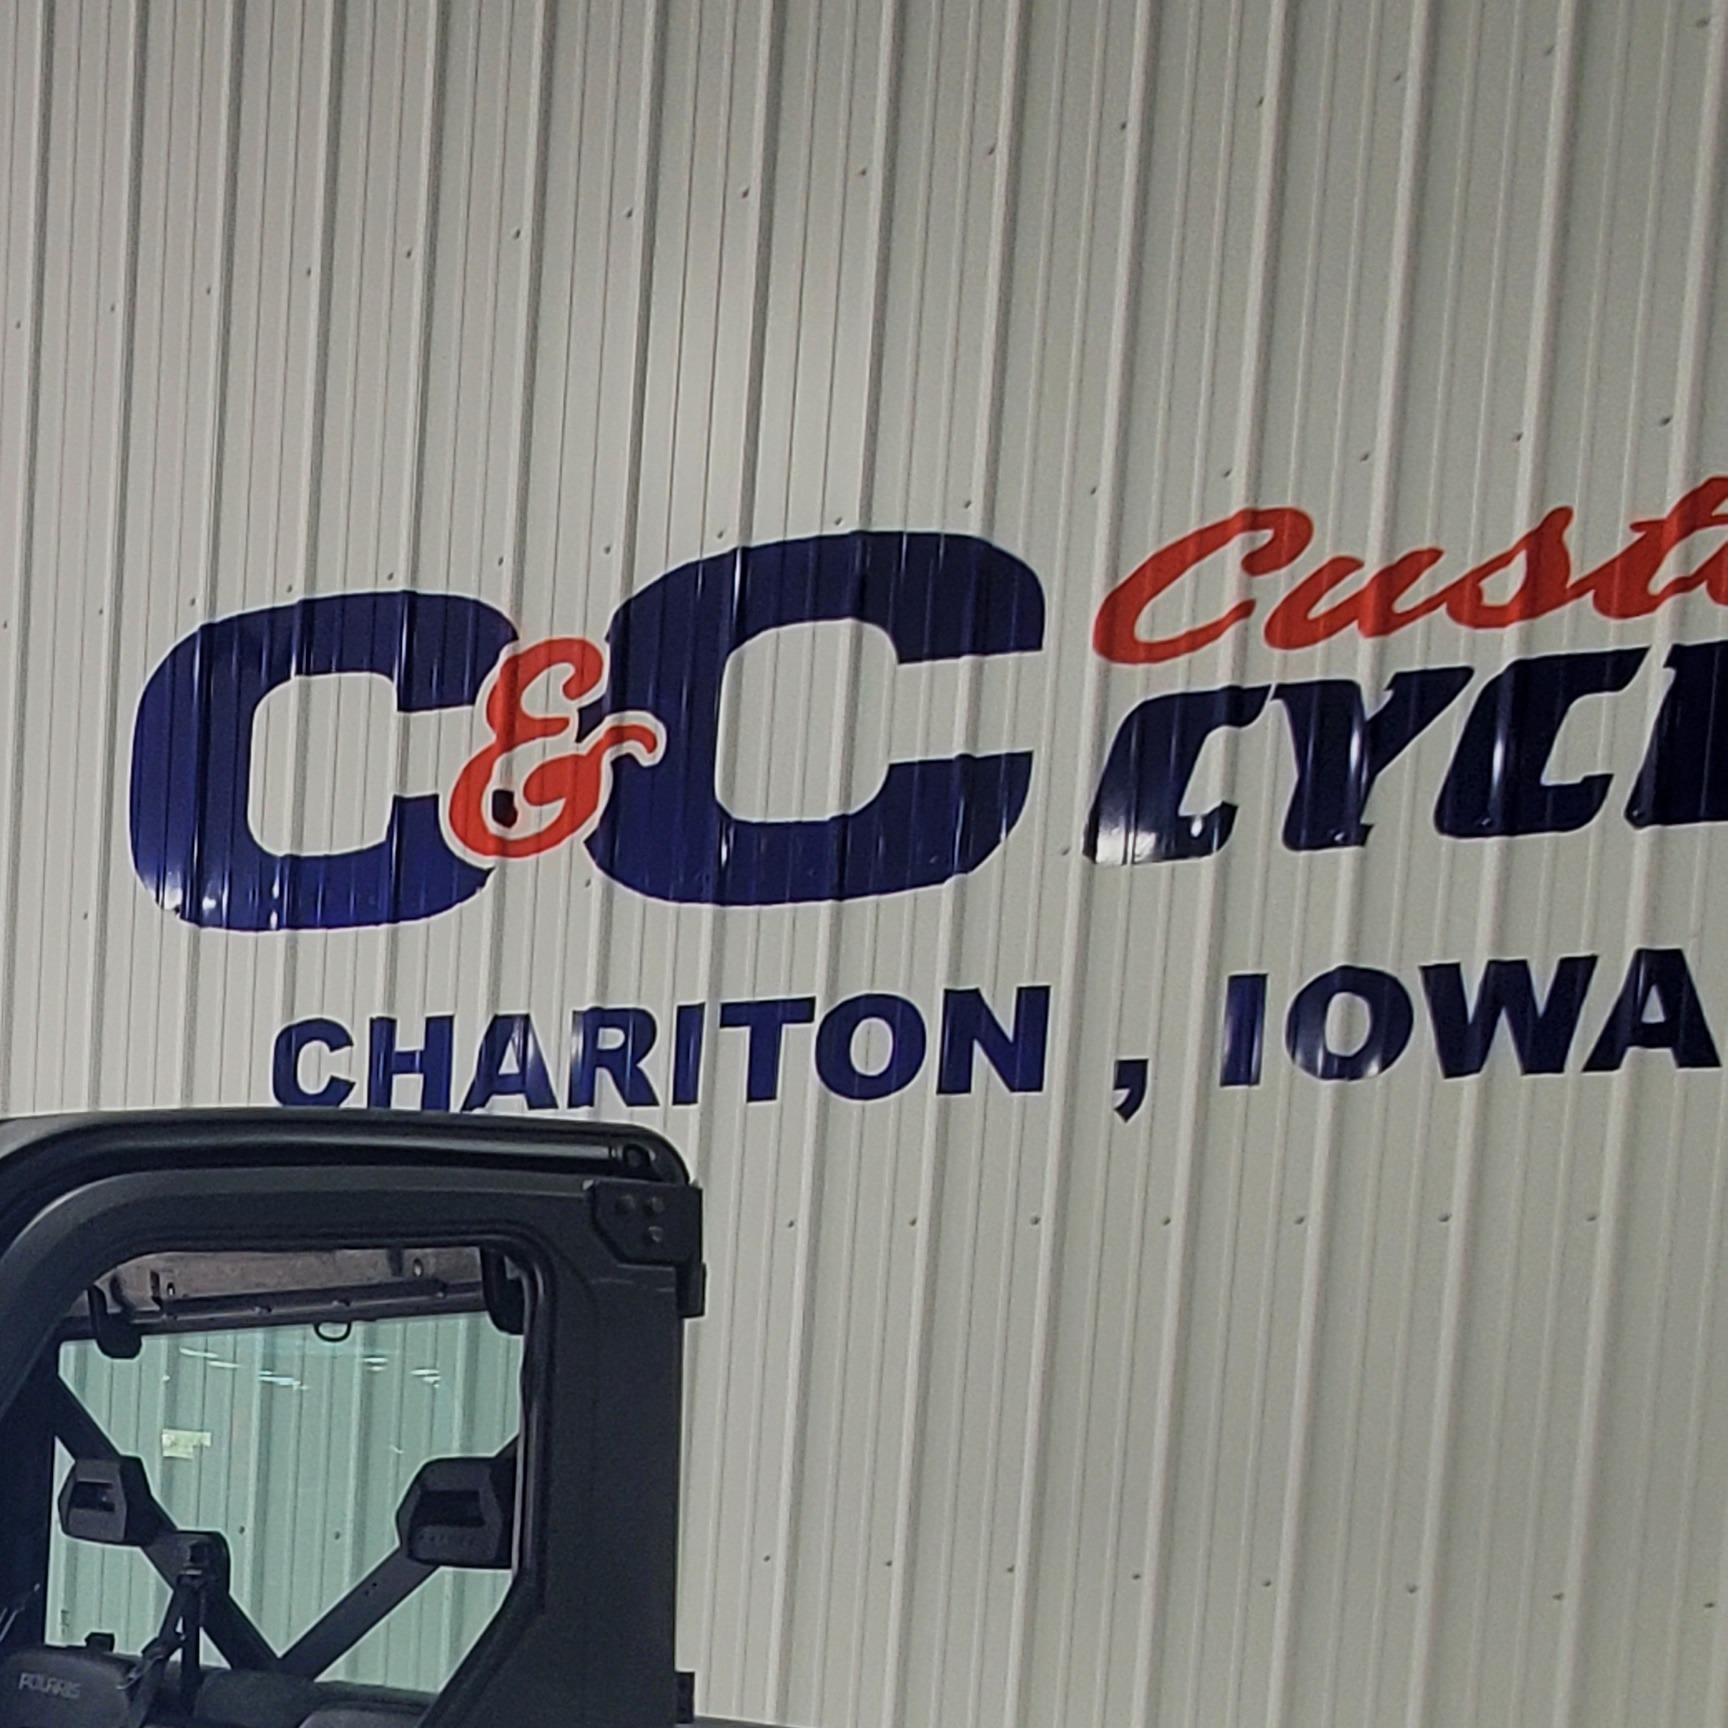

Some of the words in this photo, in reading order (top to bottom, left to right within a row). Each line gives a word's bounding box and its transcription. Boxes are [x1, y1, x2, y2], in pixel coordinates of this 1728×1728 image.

[1093, 476, 1728, 664] Cust
[129, 530, 1046, 931] C&C
[273, 985, 1050, 1113] CHARITON
[1219, 948, 1723, 1088] IOWA
